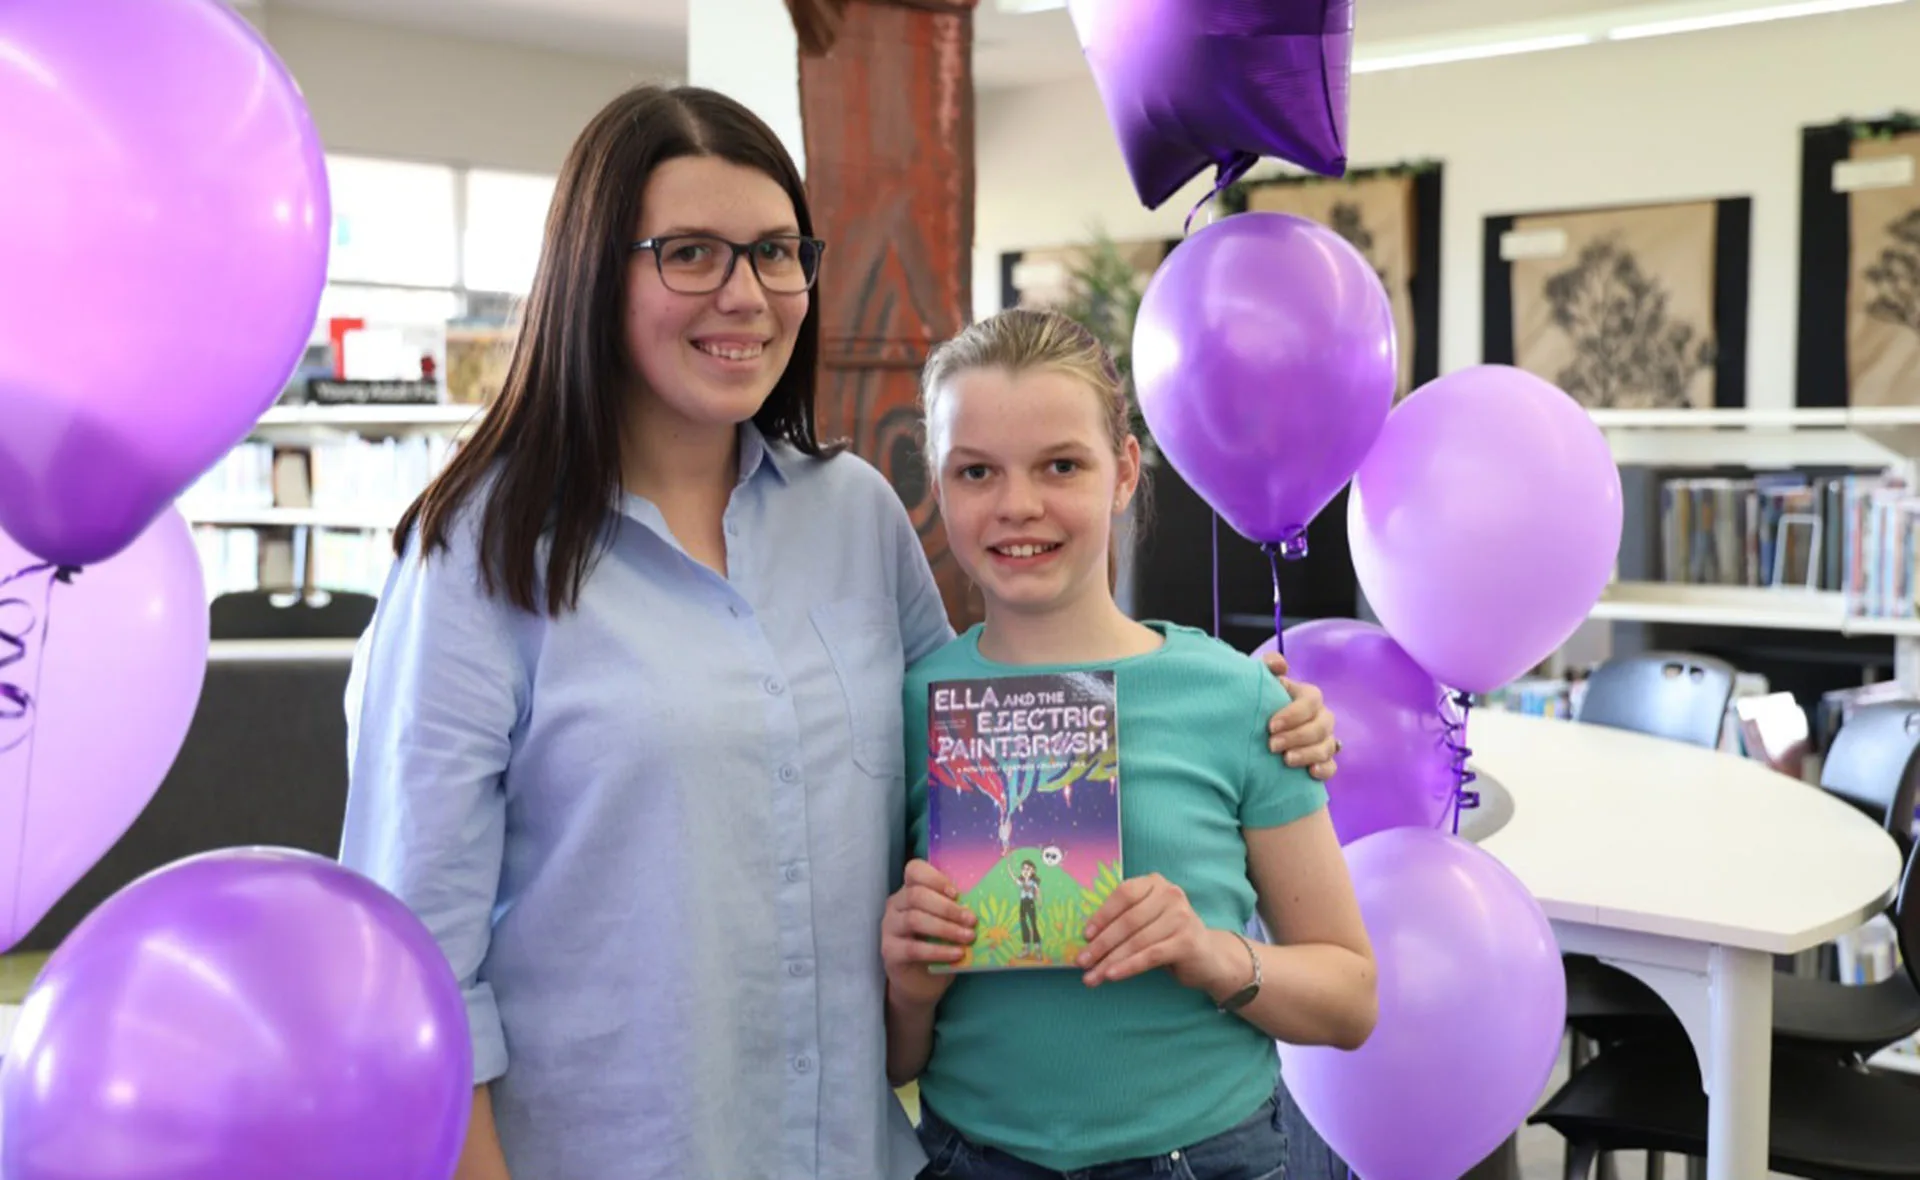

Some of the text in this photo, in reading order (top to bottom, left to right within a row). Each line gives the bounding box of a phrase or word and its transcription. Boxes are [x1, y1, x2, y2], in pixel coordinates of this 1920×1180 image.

[935, 686, 999, 711] ELLA
[1003, 692, 1035, 706] AND
[1037, 691, 1065, 704] THE
[977, 704, 1107, 733] ELECTRIC
[935, 731, 1108, 764] PAINTBRUSH
